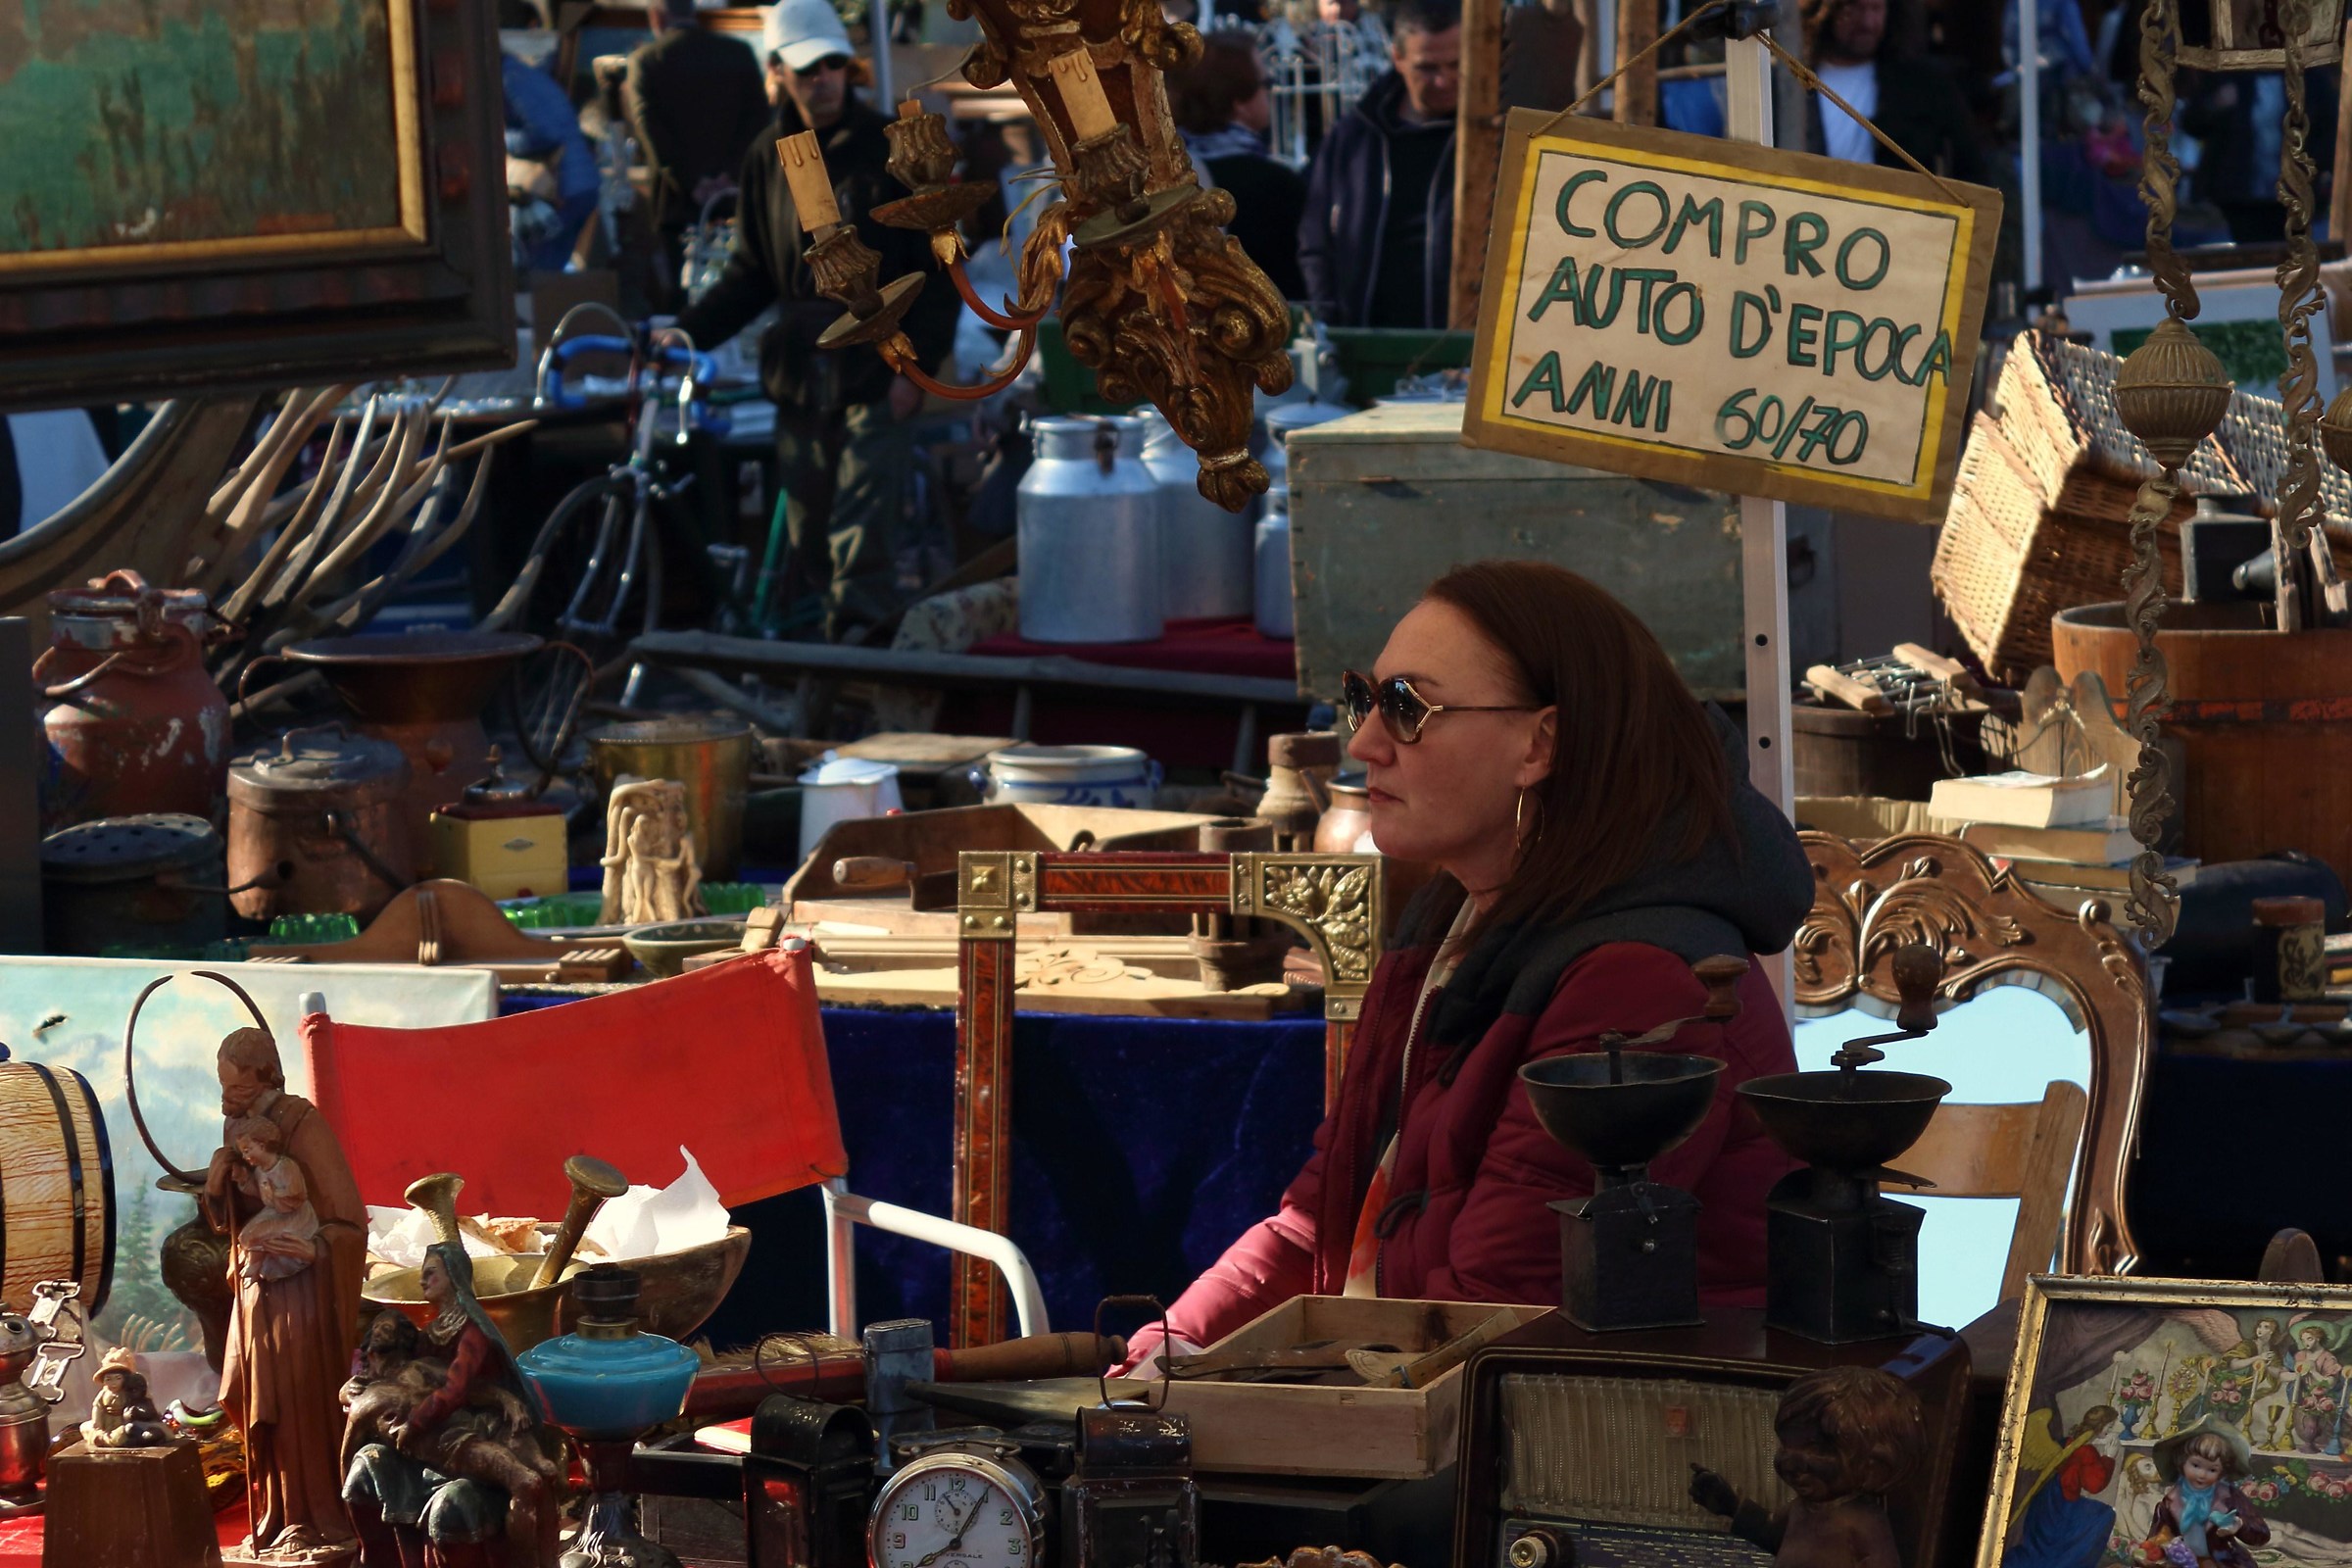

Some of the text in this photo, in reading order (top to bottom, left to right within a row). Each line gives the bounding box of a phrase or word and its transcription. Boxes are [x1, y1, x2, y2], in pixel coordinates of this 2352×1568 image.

[1555, 170, 1890, 291] COMPRO
[1527, 256, 1953, 387] AUTO D'EPOCA
[1511, 350, 1869, 466] ANNI 60/70
[901, 1504, 919, 1521] 10
[1000, 1508, 1013, 1525] 2
[893, 1532, 906, 1548] 9
[1007, 1538, 1021, 1554] 3
